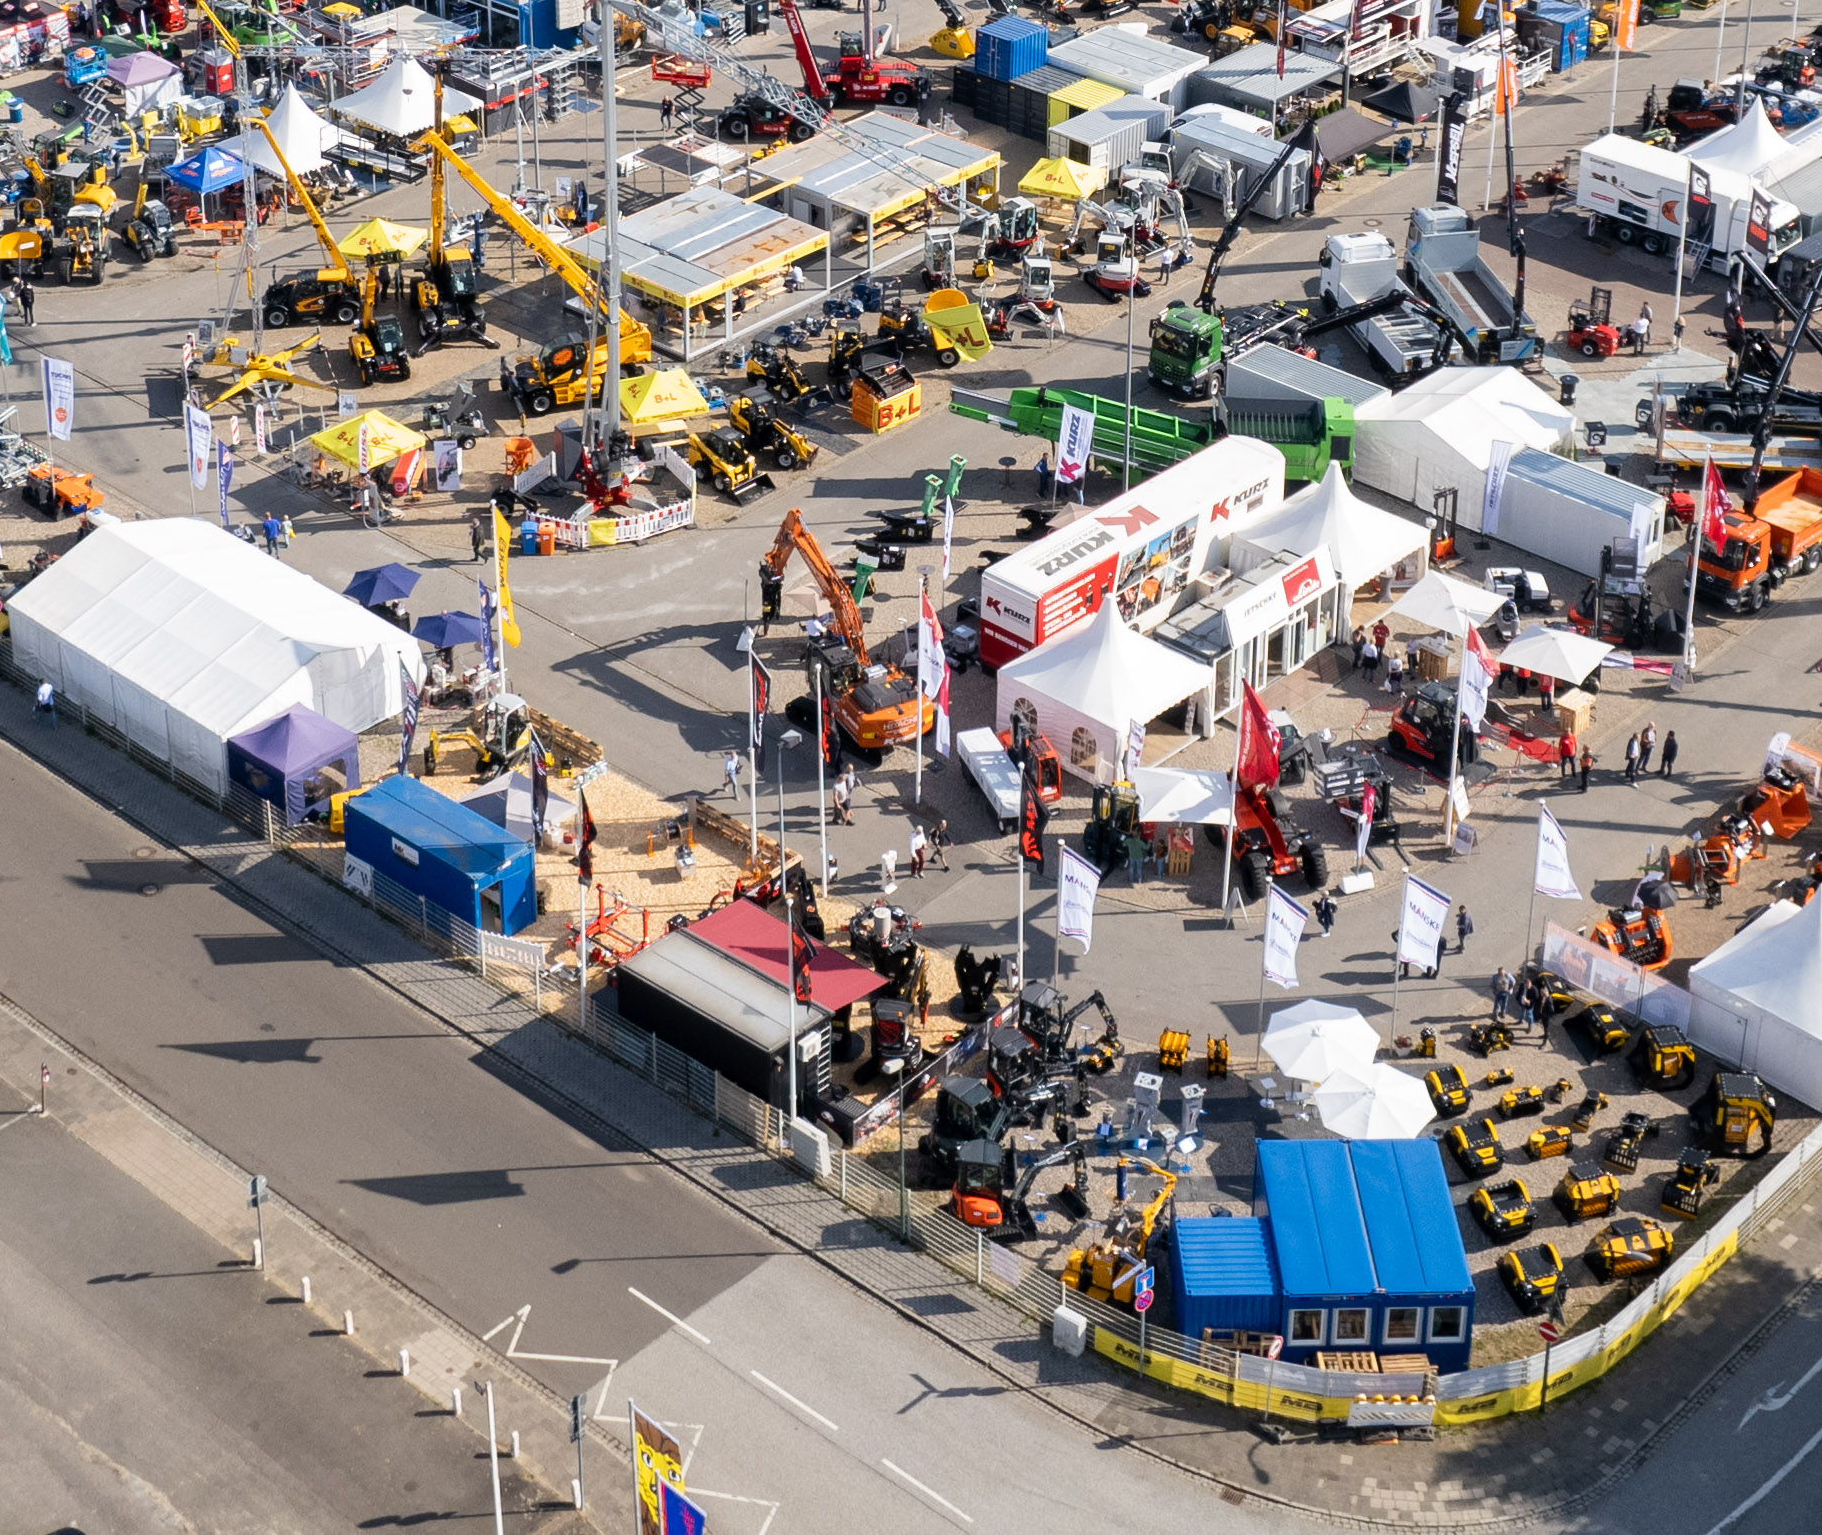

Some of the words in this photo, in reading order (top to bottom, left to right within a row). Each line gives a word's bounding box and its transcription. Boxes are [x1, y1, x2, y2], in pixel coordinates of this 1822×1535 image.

[1445, 122, 1464, 184] KOEPSELL
[654, 393, 678, 404] B+L
[879, 393, 921, 429] B+L
[1065, 413, 1082, 458] KURZ
[1233, 477, 1270, 506] KURZ
[1036, 530, 1116, 577] KURZ
[1003, 607, 1031, 626] KURZ
[1409, 900, 1441, 934] MANSKE
